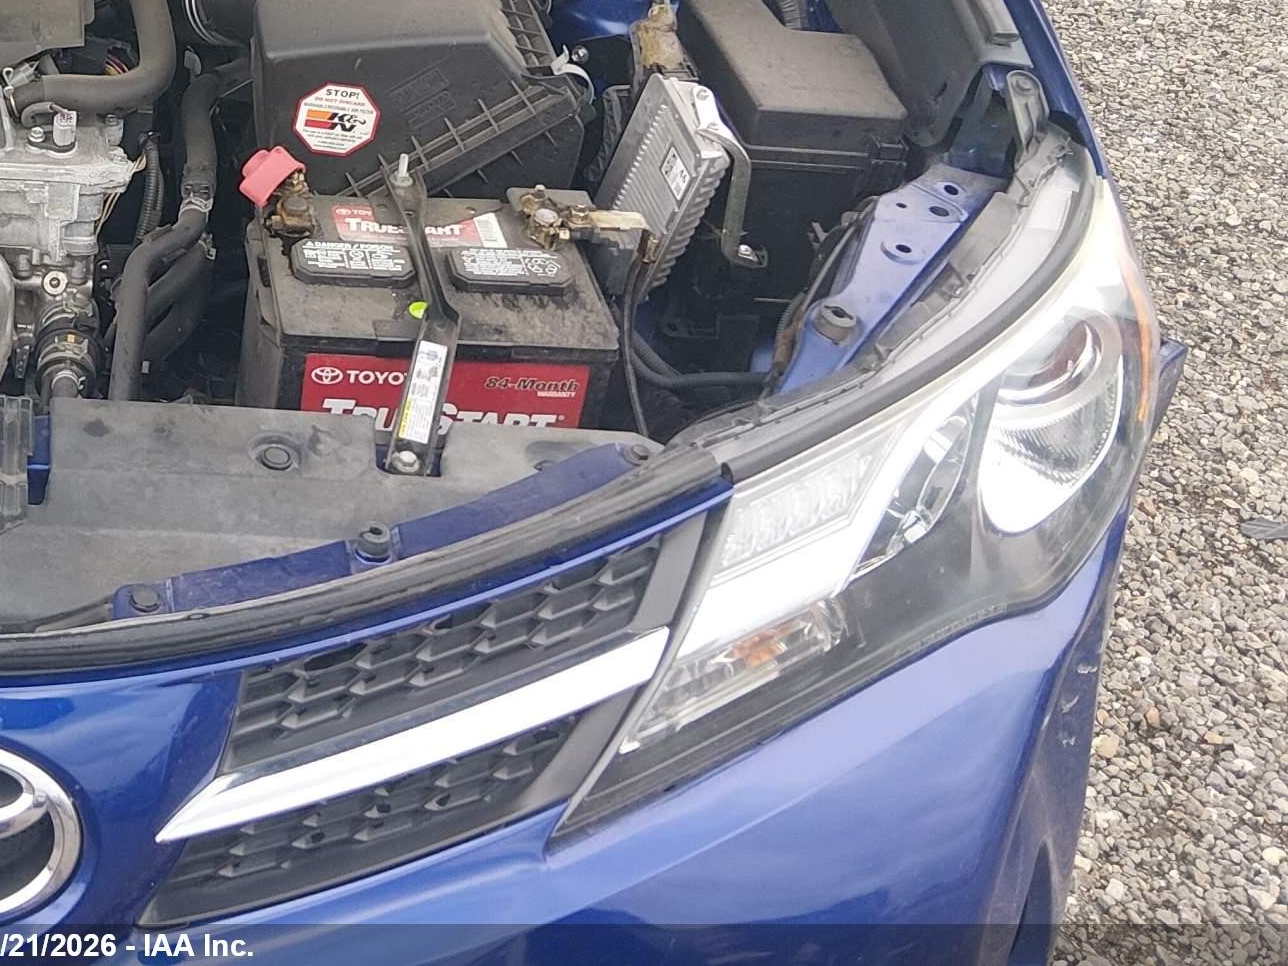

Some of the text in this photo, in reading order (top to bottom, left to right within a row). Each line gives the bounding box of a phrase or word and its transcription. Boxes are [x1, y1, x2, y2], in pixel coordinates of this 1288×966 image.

[325, 88, 360, 100] STOP!
[346, 370, 408, 386] TOYO
[484, 376, 579, 394] 84-Month
